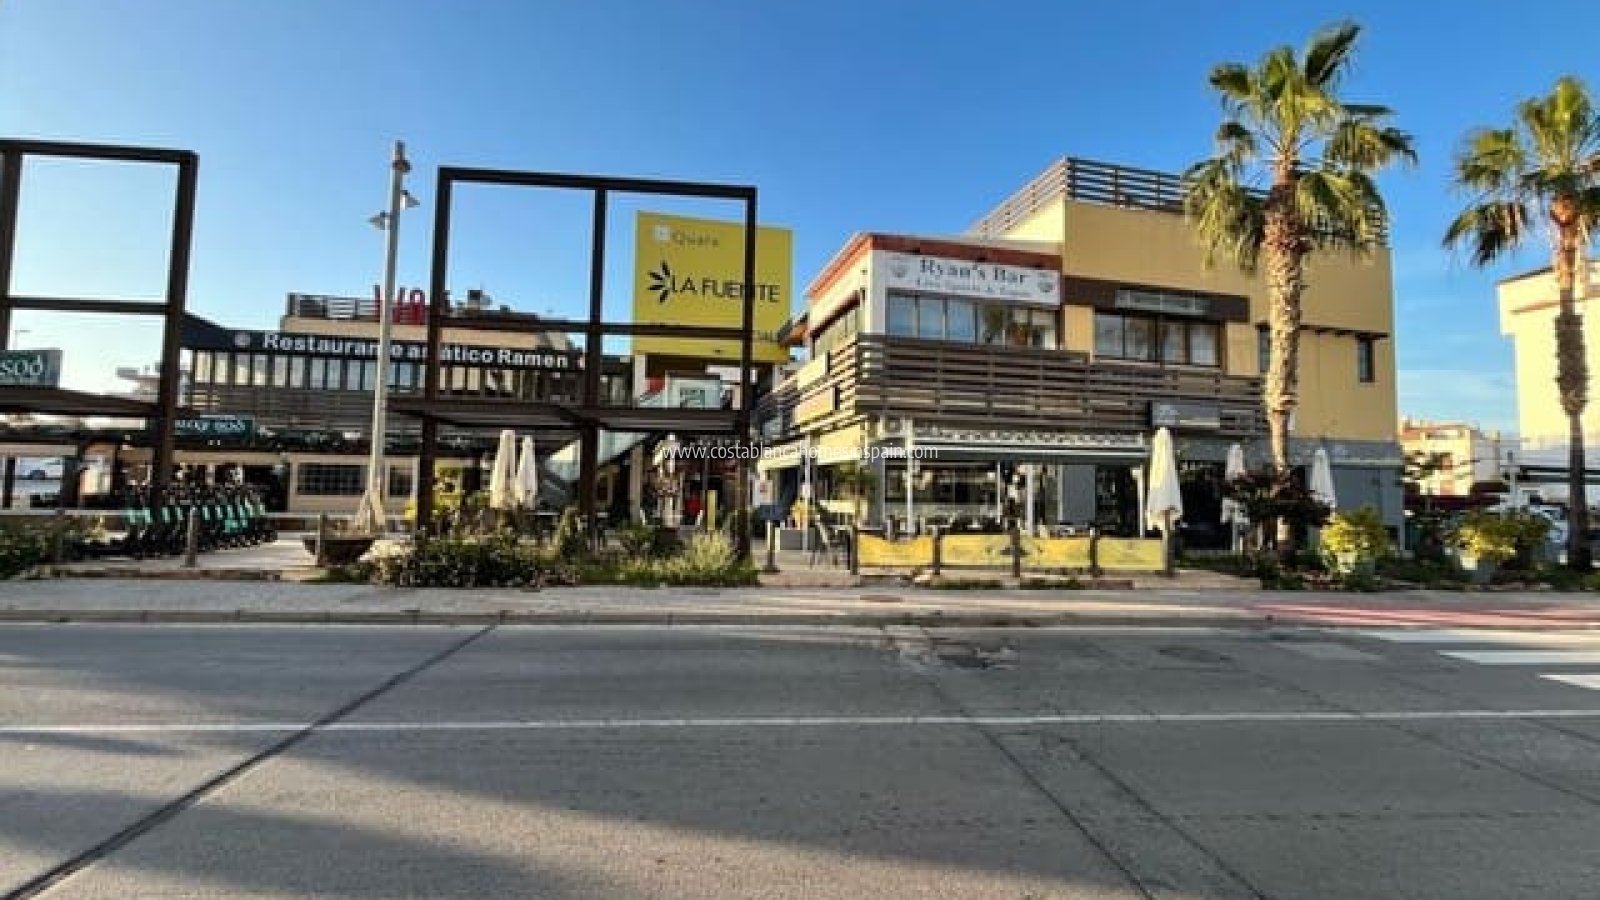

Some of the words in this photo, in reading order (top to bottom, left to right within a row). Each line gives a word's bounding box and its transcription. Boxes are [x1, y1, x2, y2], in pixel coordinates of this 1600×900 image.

[672, 274, 698, 296] LA
[919, 258, 986, 280] Ryan's
[992, 266, 1029, 286] Bar
[264, 329, 404, 359] Restaurane
[497, 347, 569, 370] Ramen
